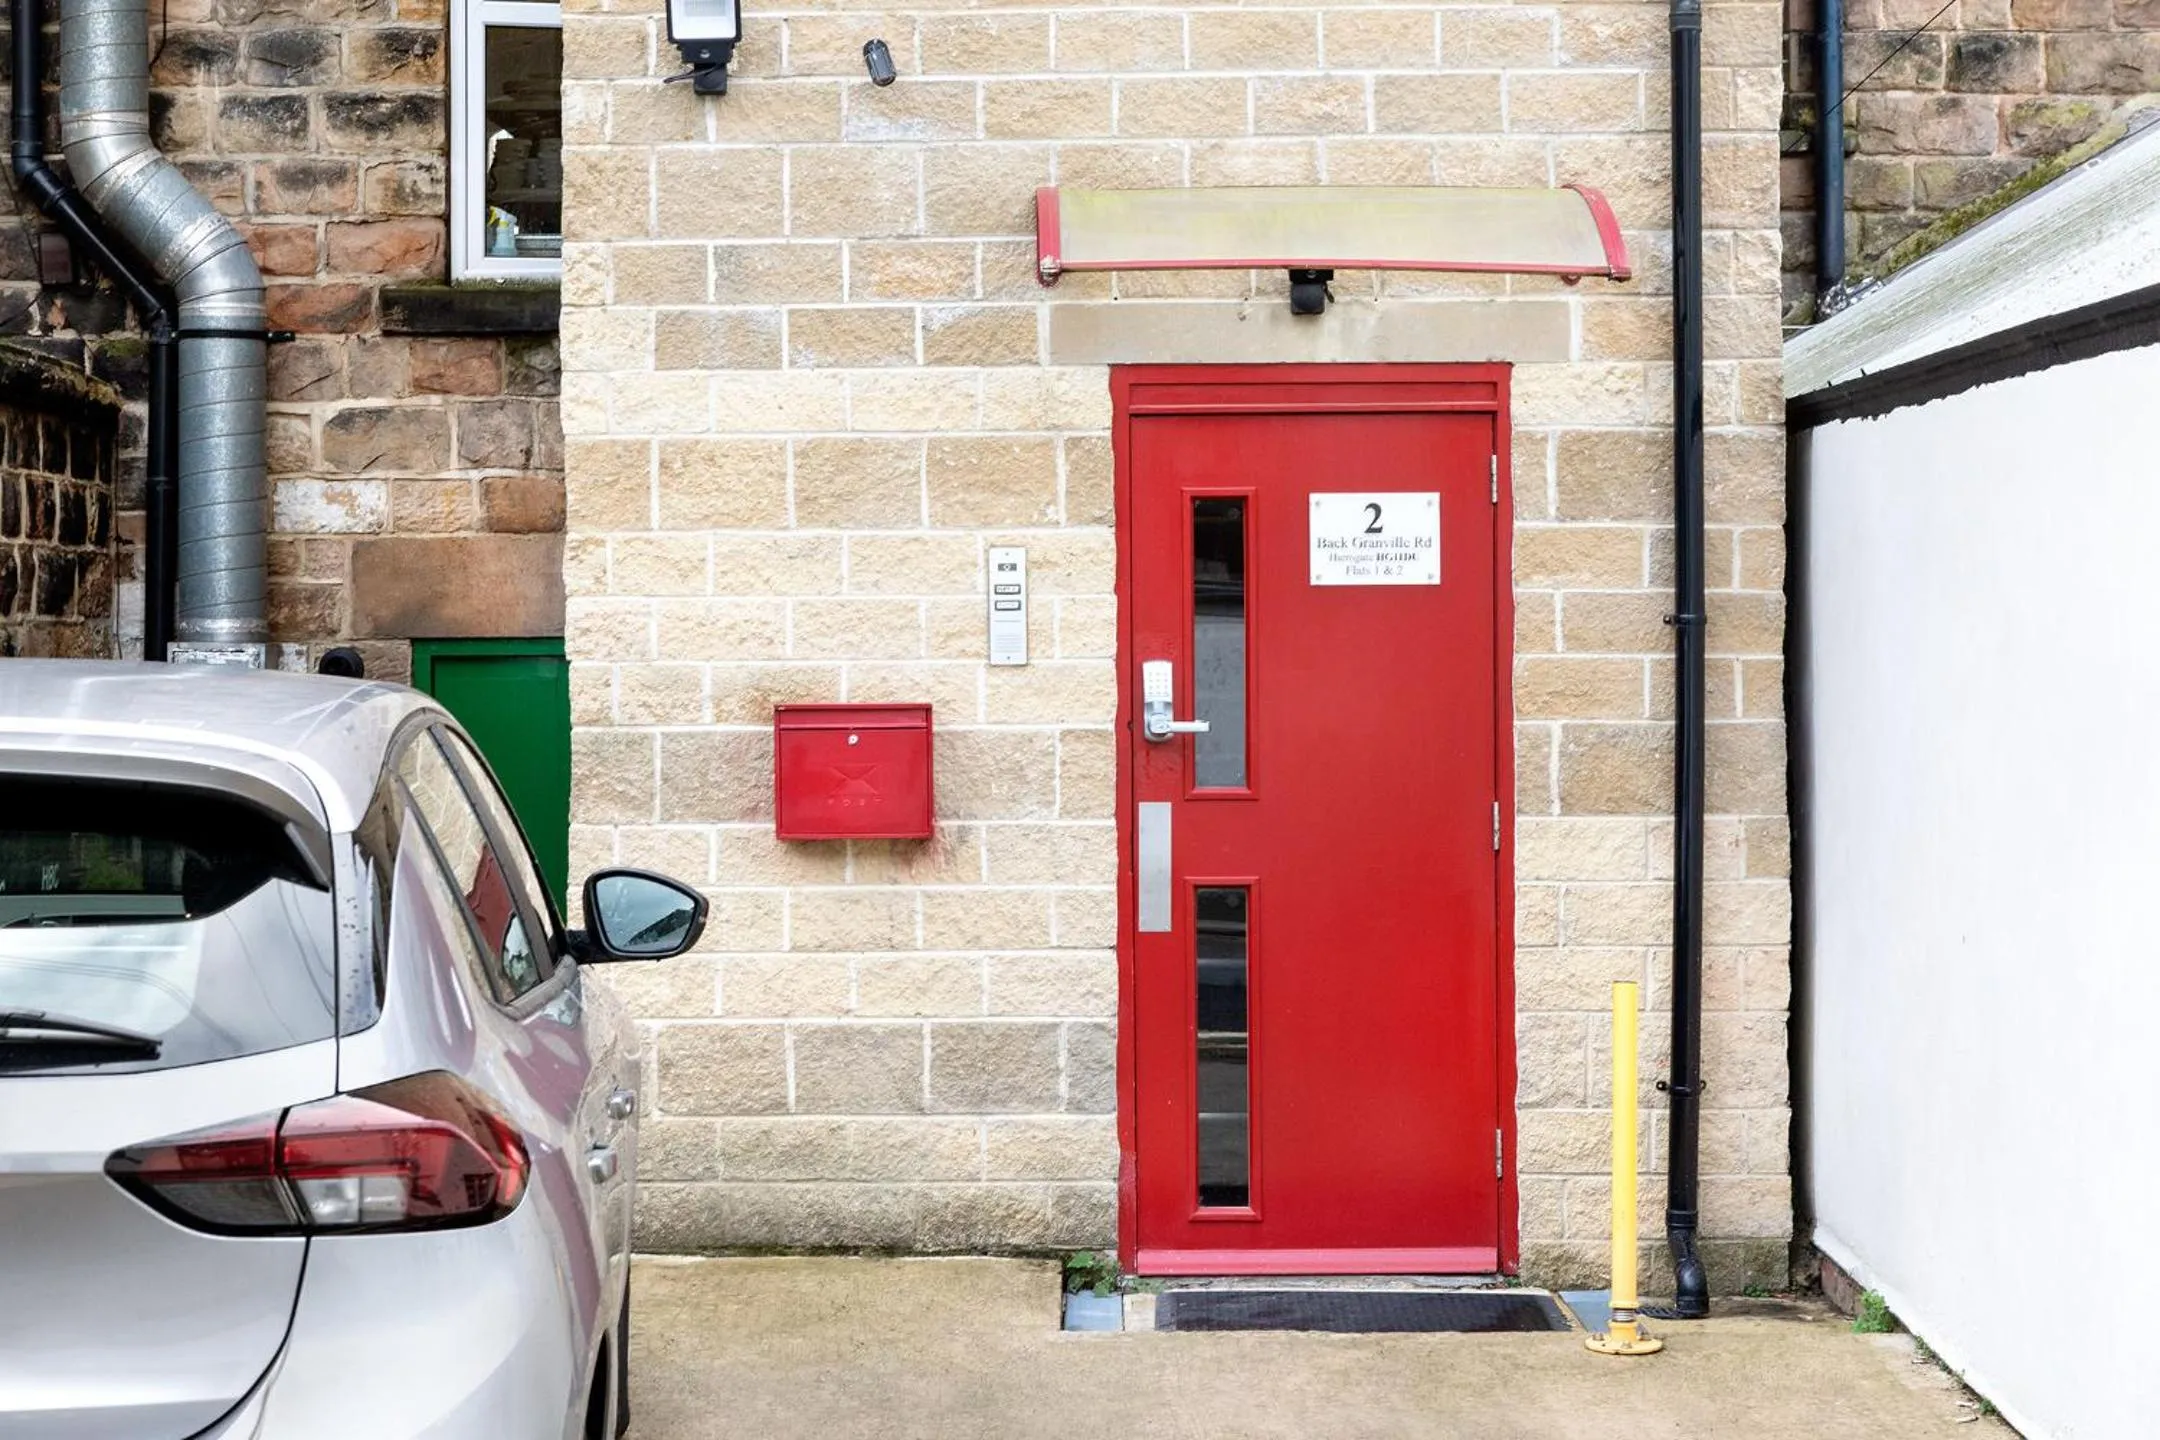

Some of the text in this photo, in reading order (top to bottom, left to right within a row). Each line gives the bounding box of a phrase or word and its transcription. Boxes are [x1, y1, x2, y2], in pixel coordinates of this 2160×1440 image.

[1364, 503, 1384, 534] 2
[1317, 536, 1432, 549] Back Granville Rd
[1346, 565, 1371, 576] Flats
[1383, 565, 1393, 575] &
[1396, 565, 1404, 576] 2
